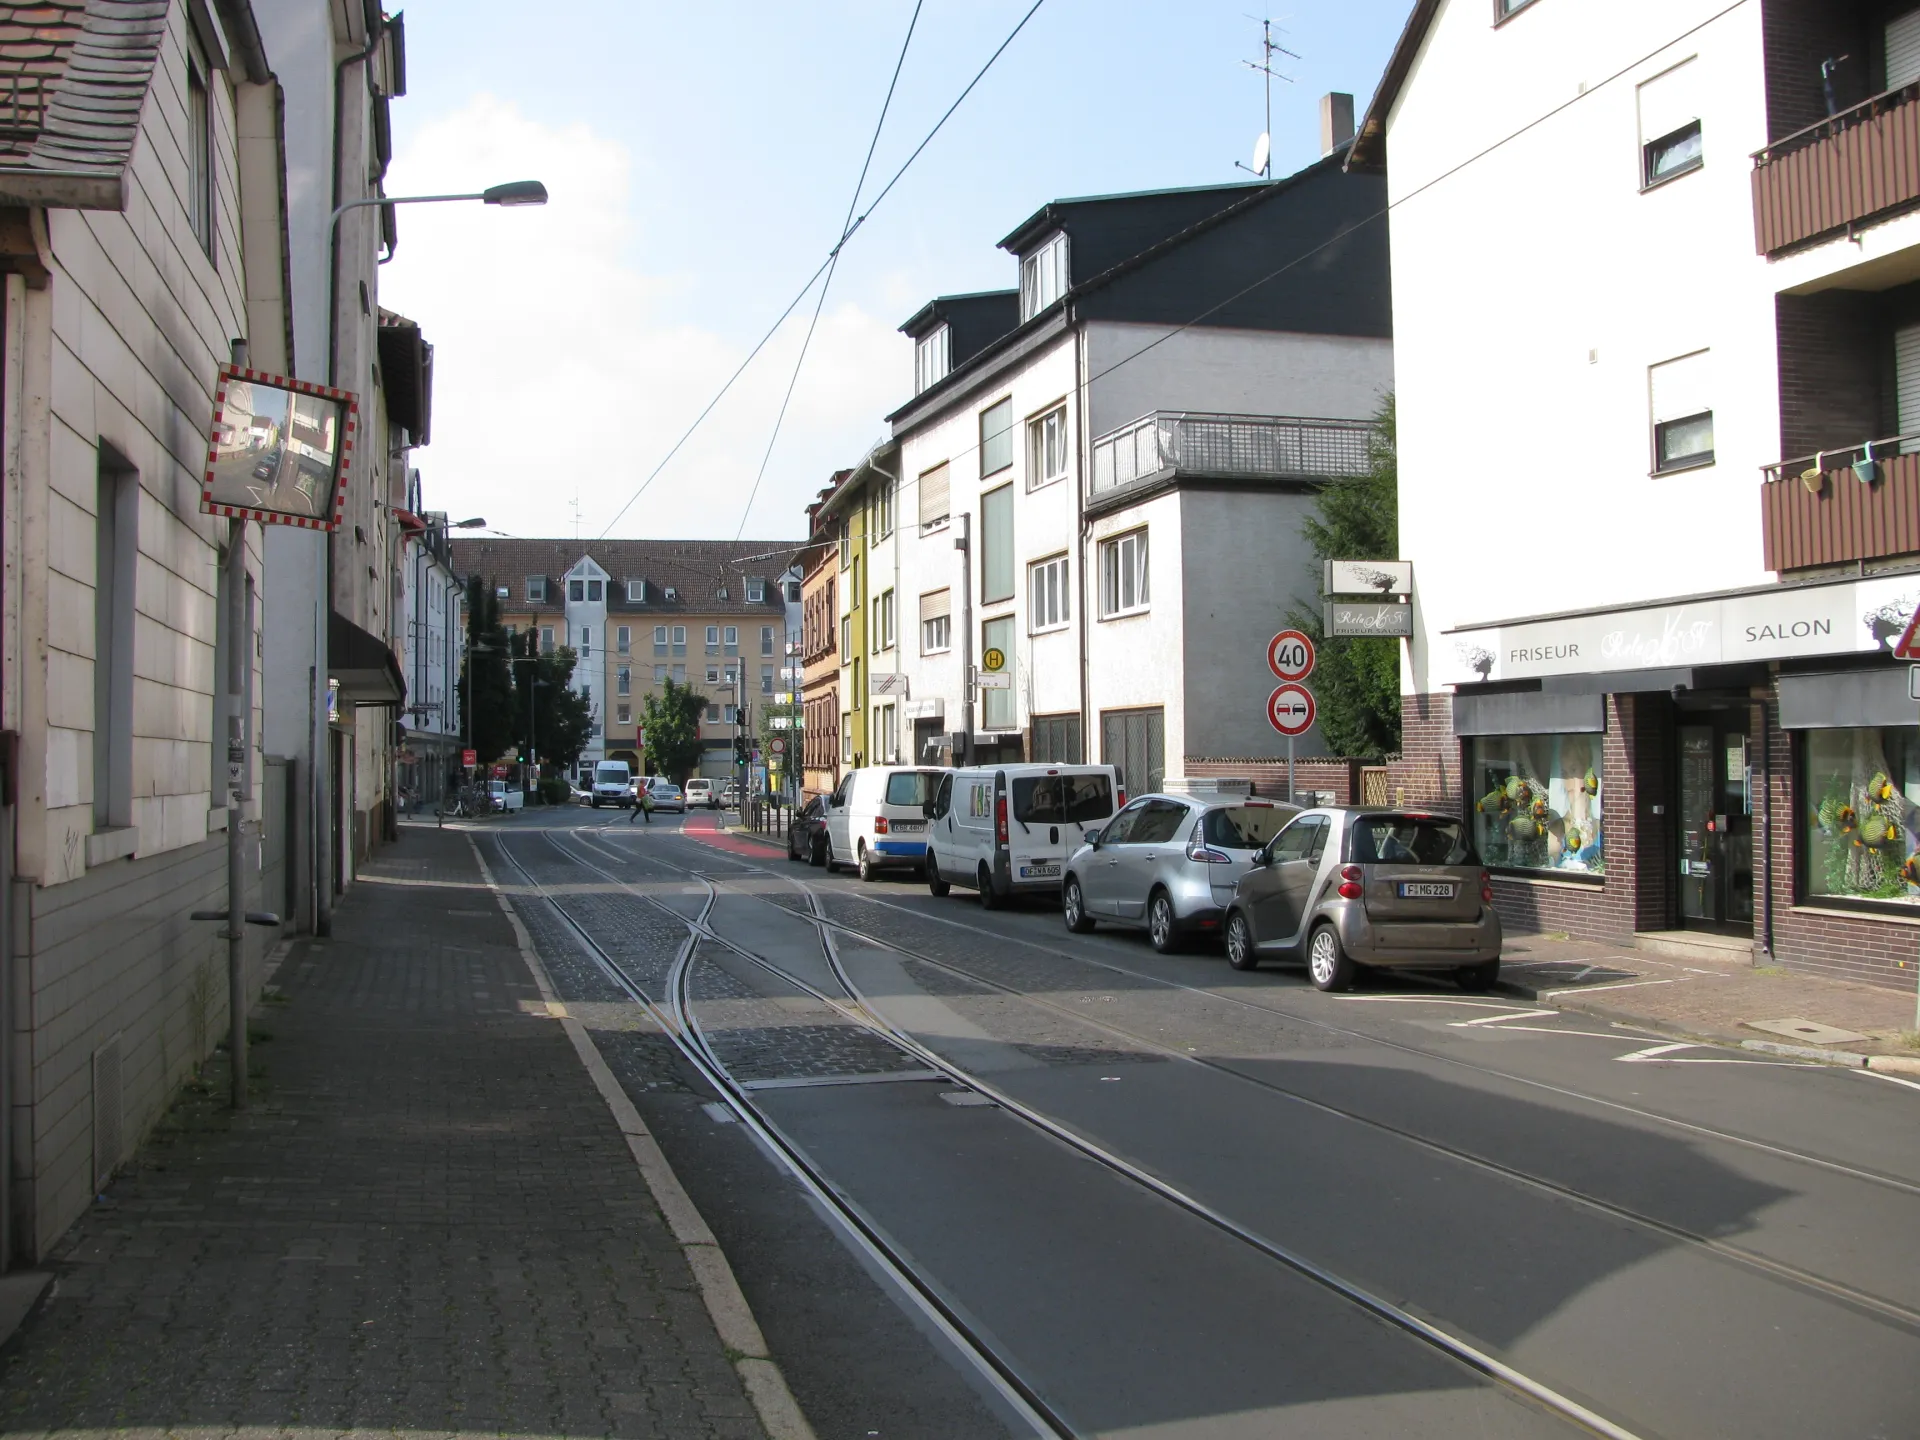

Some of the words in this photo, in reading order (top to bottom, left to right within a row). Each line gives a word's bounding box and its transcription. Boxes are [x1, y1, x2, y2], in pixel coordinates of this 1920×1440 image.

[1745, 618, 1831, 643] SALON
[989, 653, 999, 666] H
[1278, 644, 1305, 667] 40
[1510, 644, 1580, 663] FRISEUR
[1407, 885, 1414, 894] F
[1420, 885, 1432, 895] MG
[1434, 885, 1450, 895] 228
